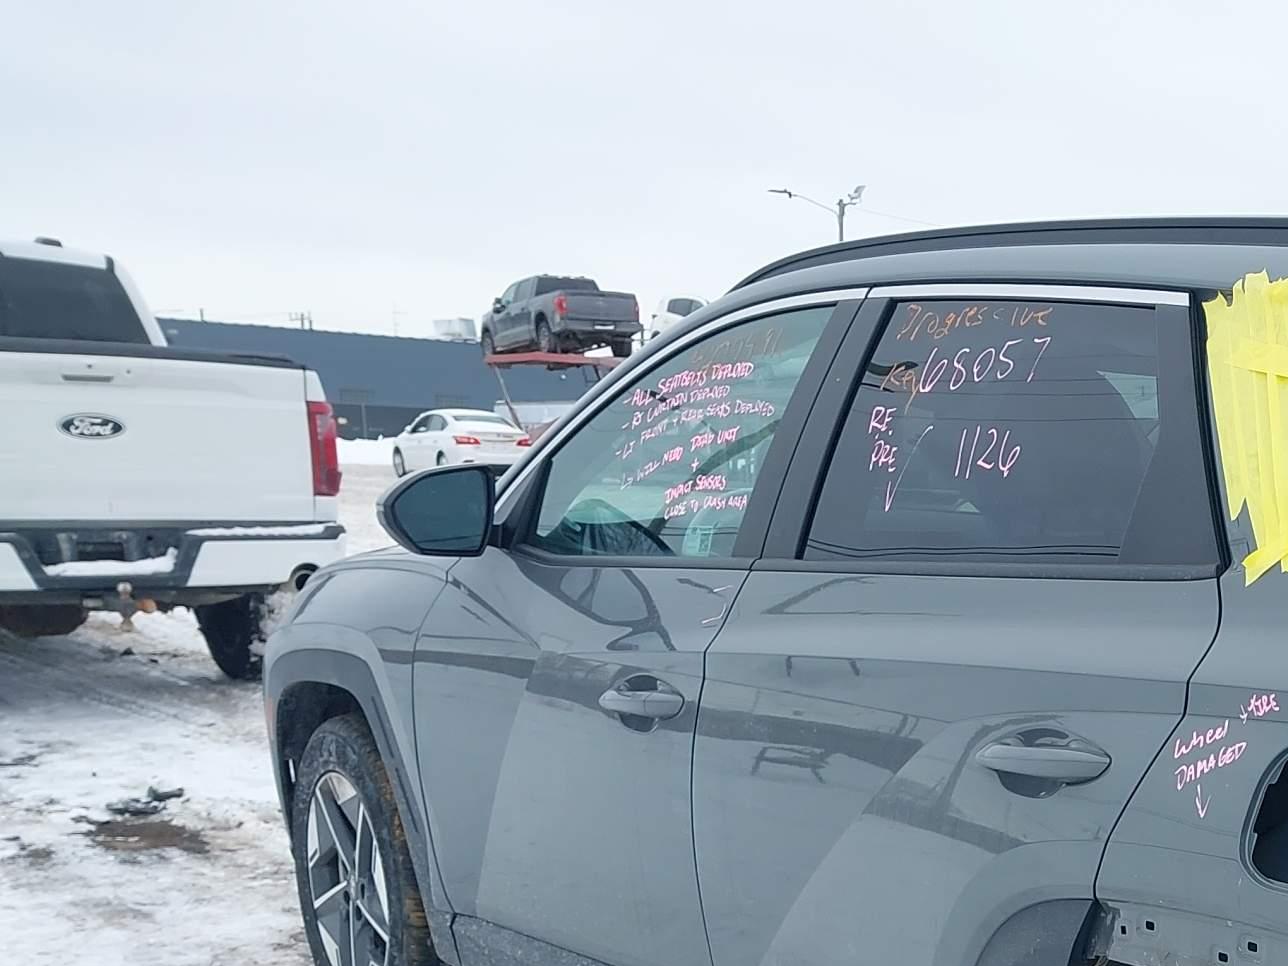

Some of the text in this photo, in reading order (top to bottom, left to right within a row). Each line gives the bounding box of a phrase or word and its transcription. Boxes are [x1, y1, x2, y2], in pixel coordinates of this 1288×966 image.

[919, 336, 1051, 393] 68057
[69, 416, 115, 435] Ford
[954, 425, 1022, 479] 1126
[1174, 741, 1248, 791] DAMAGED
